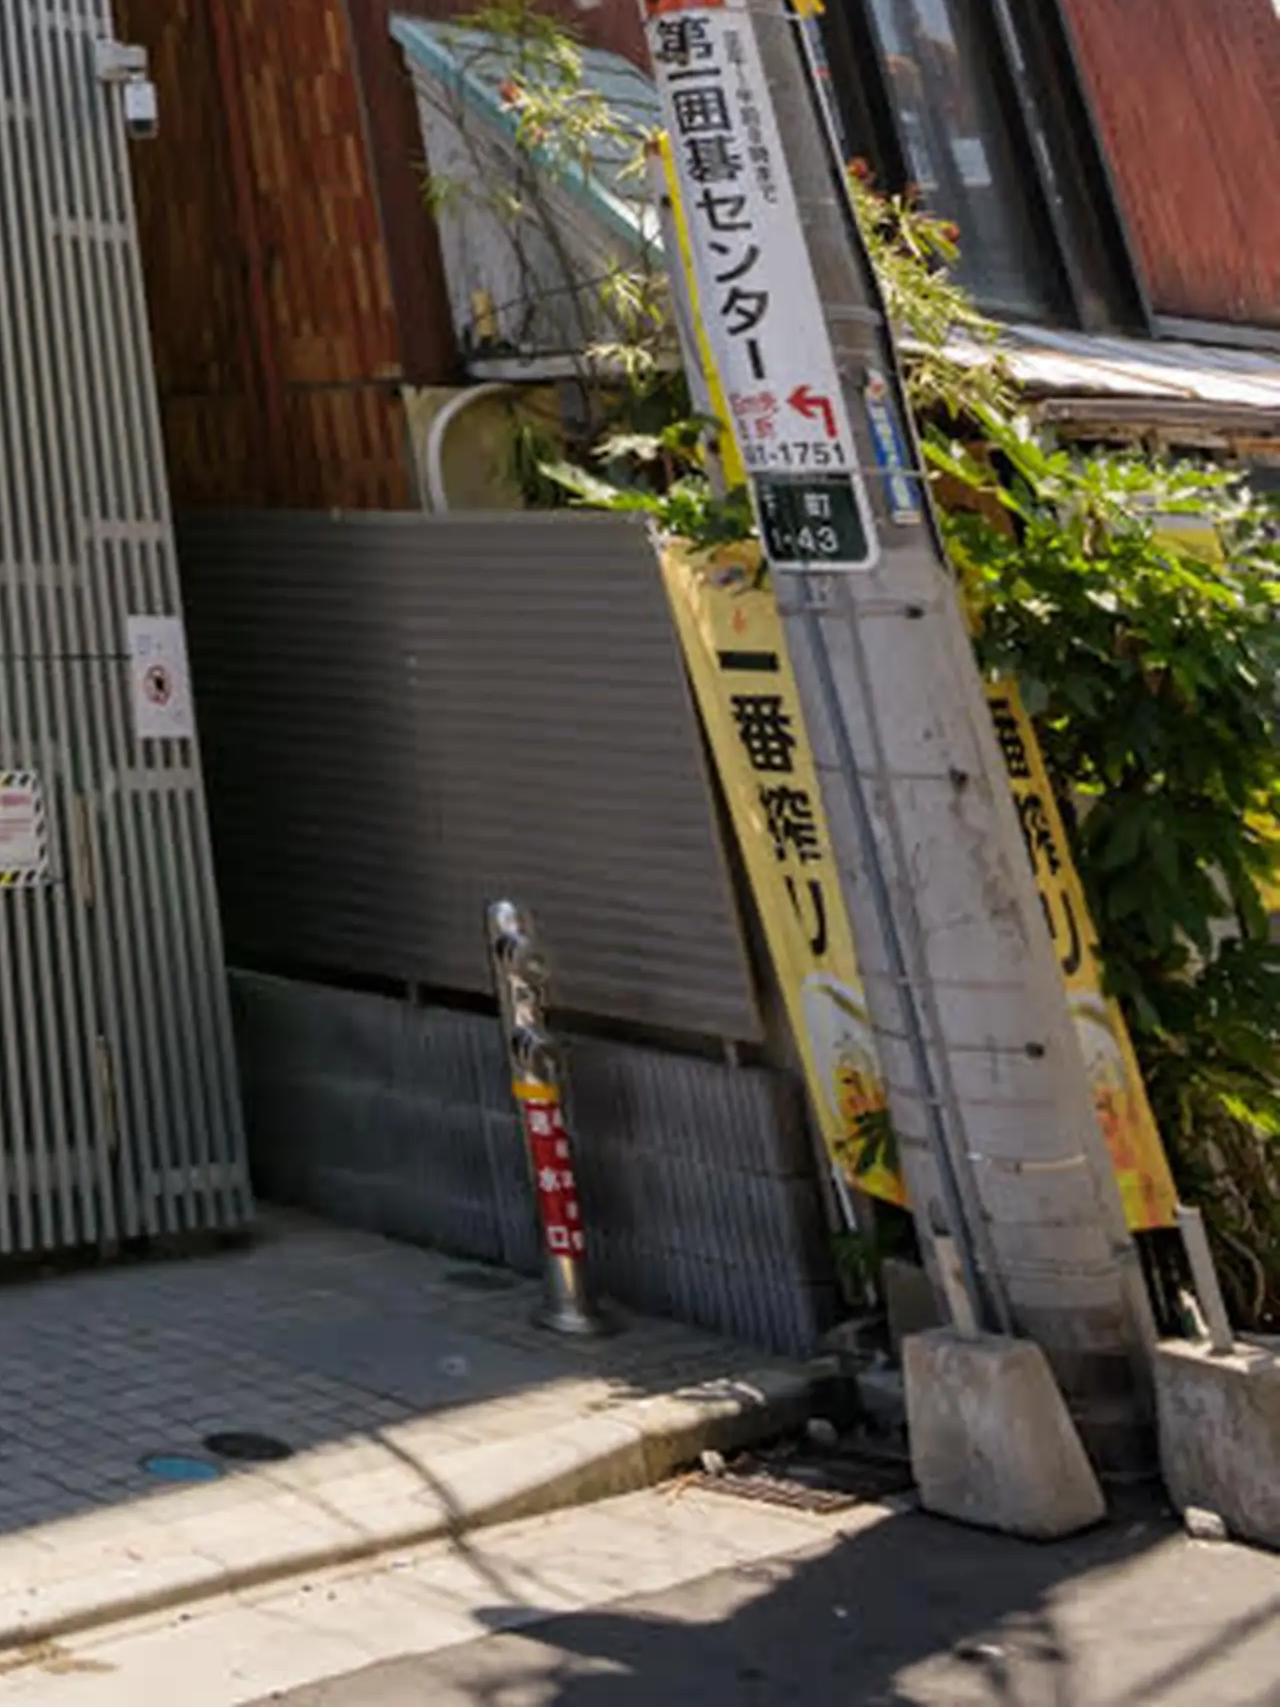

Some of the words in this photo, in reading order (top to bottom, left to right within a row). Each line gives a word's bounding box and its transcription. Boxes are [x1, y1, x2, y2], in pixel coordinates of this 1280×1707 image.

[655, 15, 769, 380] 第一囲碁センター
[716, 650, 827, 956] 一番搾り
